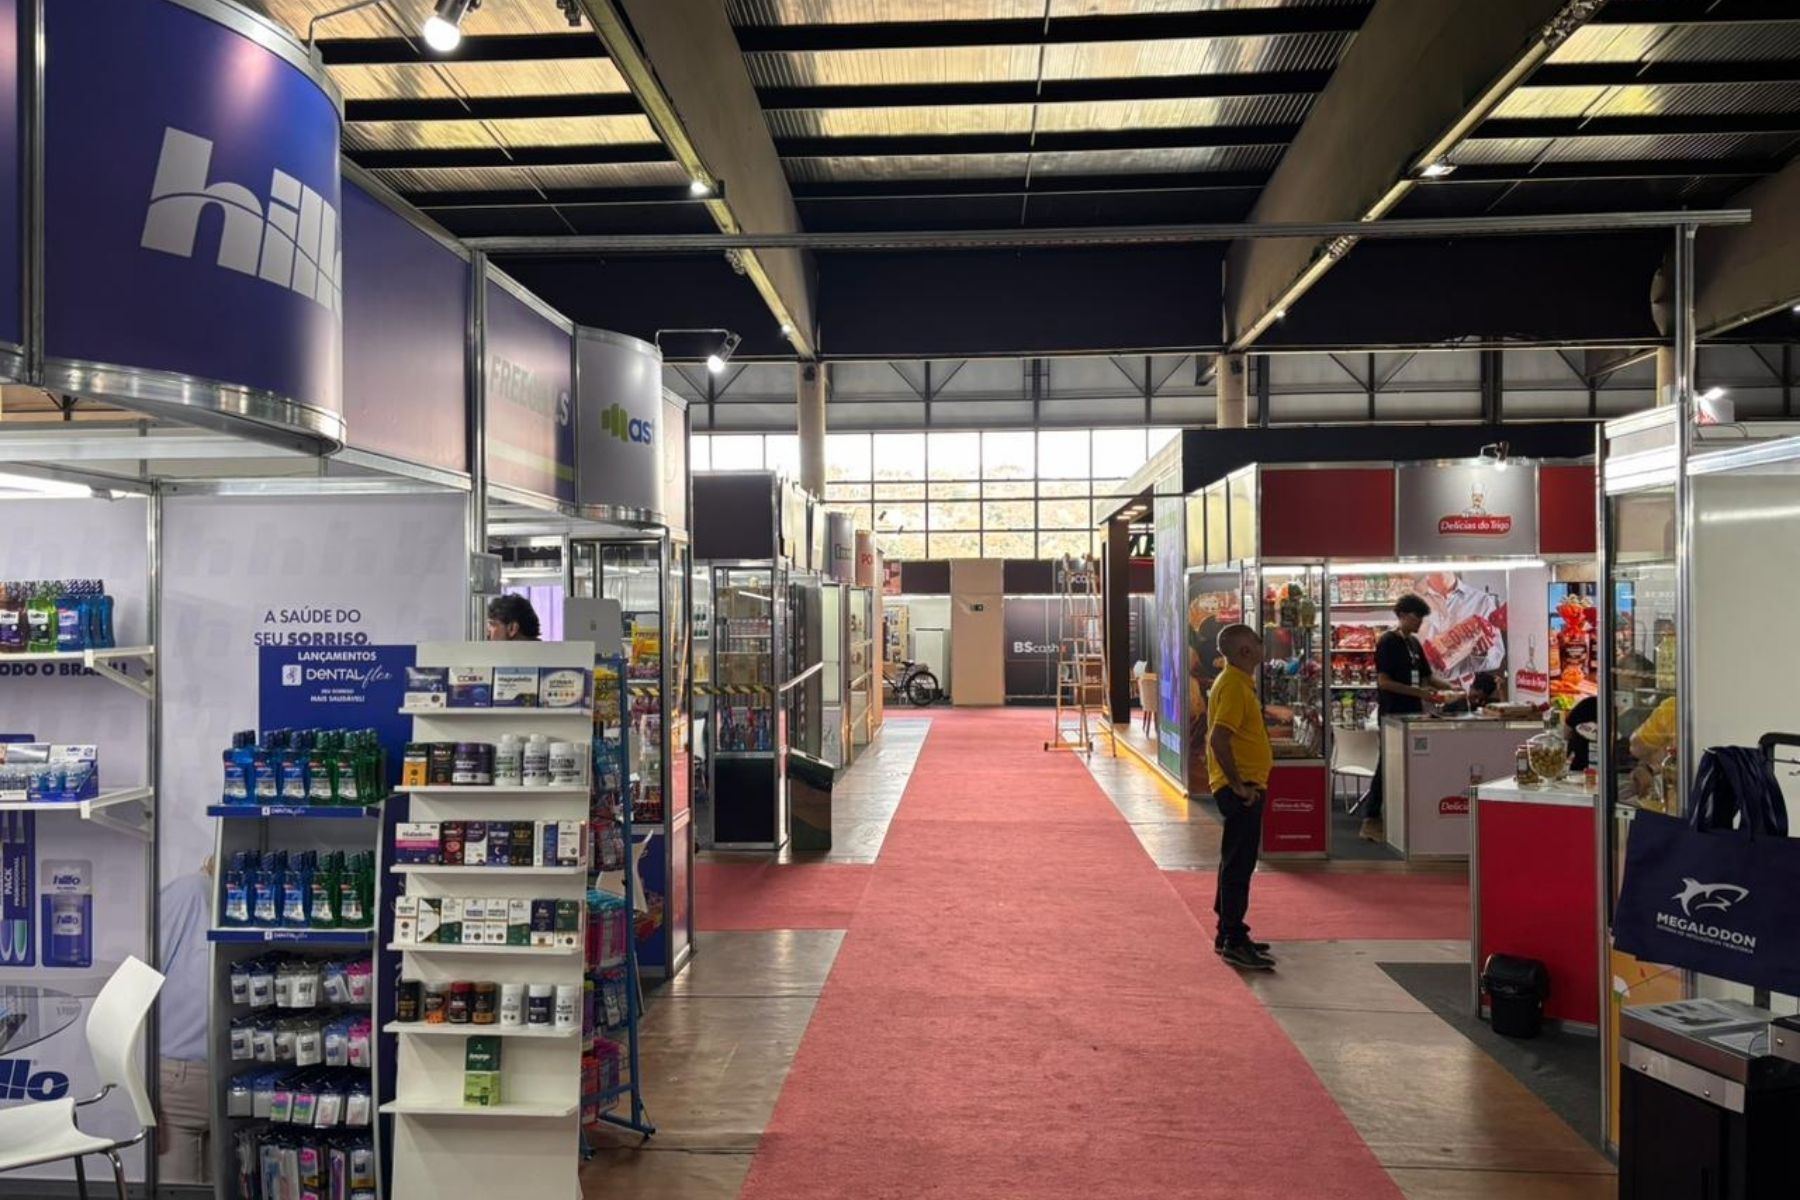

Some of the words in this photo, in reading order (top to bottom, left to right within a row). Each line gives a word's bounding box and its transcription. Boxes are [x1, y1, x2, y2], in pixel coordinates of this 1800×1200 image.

[140, 126, 343, 320] hill
[264, 611, 276, 623] A
[280, 605, 332, 623] SAÚDE
[335, 610, 361, 623] DO
[254, 632, 283, 645] SEU
[1013, 641, 1060, 653] BScash
[297, 651, 377, 663] LANÇAMENTOS
[42, 663, 54, 676] O
[4, 868, 13, 895] PACK
[1656, 911, 1756, 948] MEGALODON
